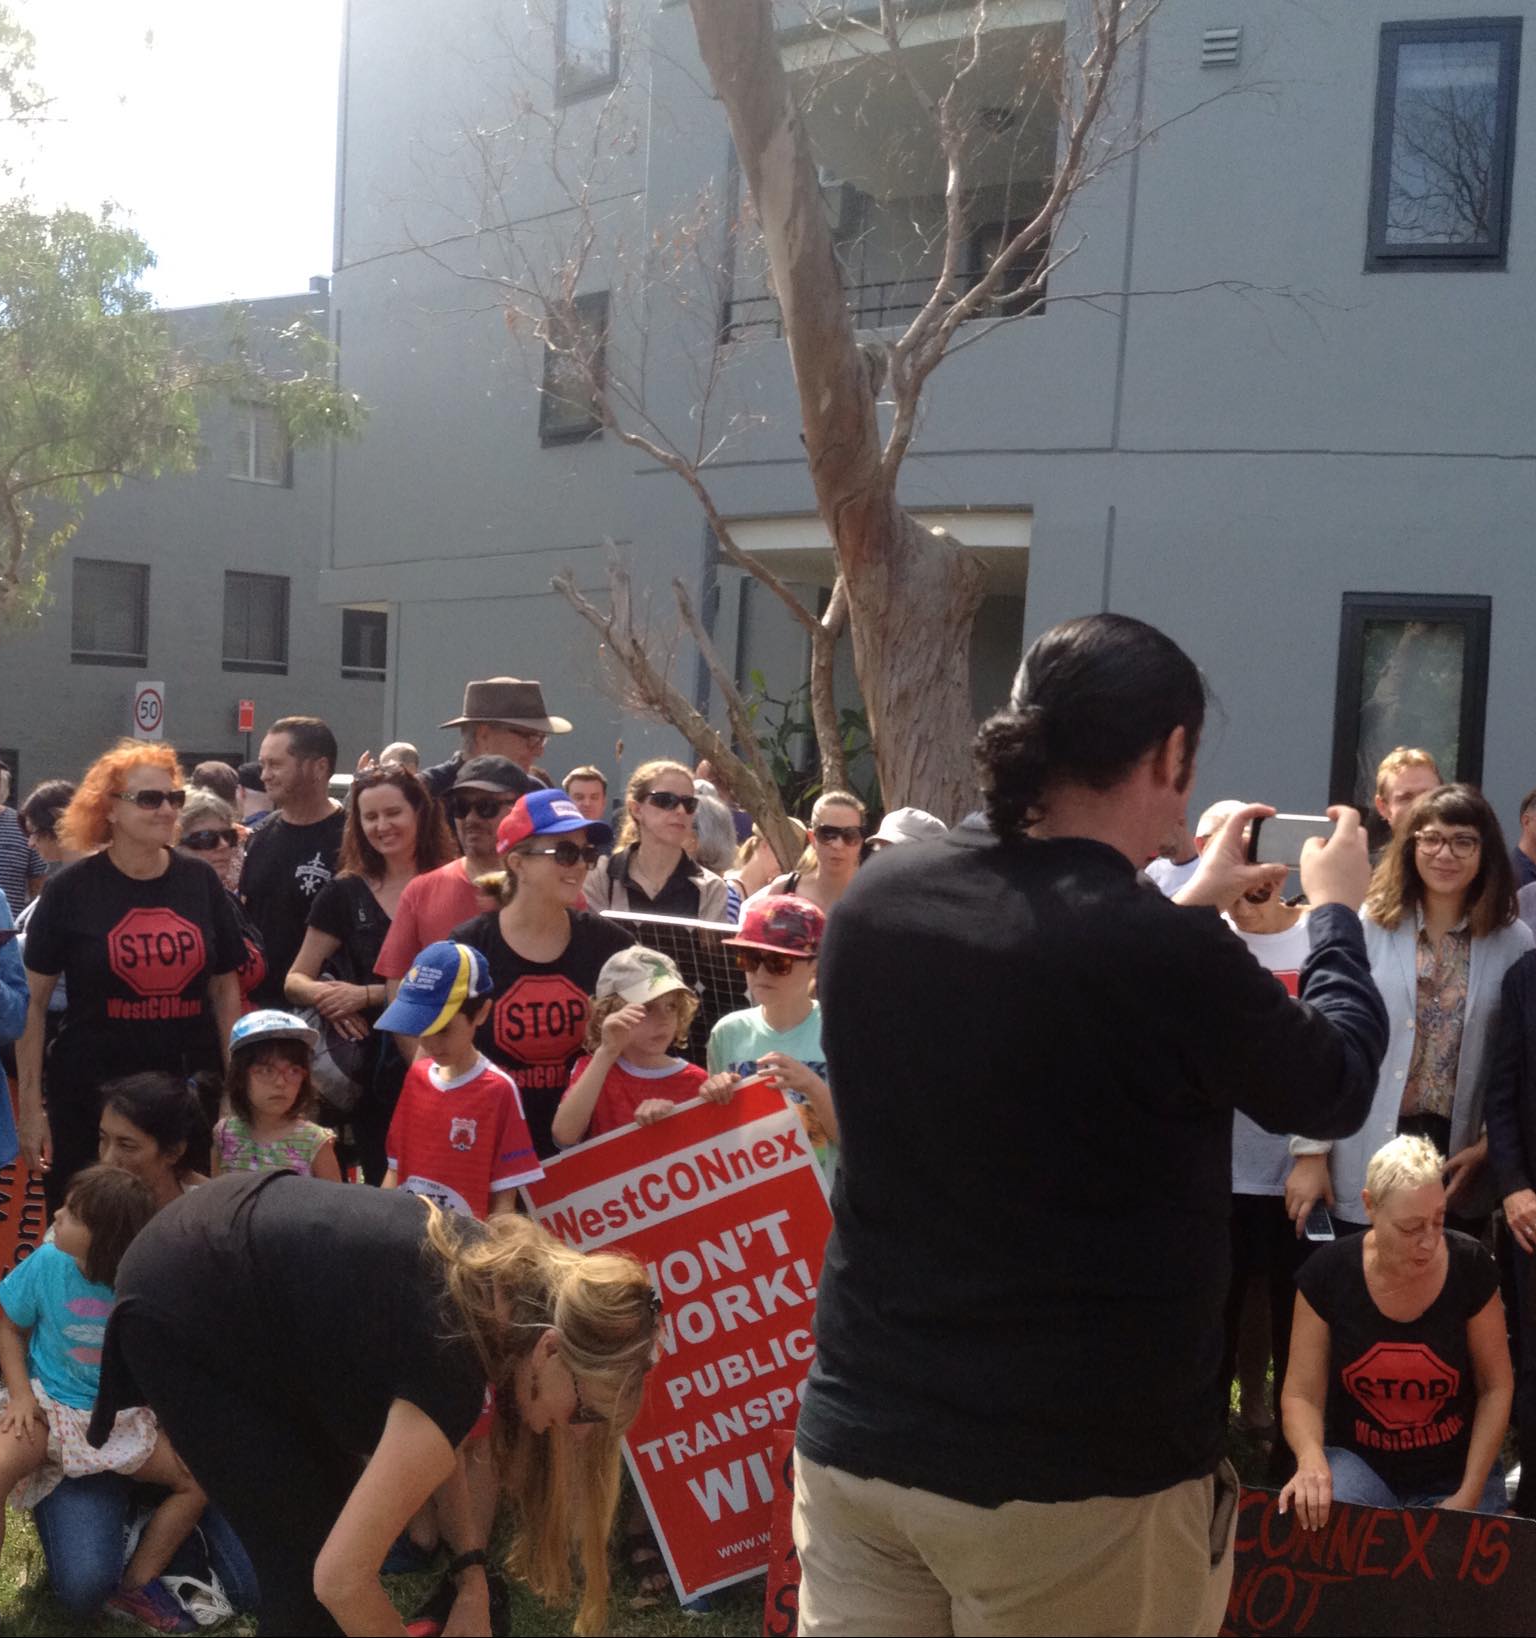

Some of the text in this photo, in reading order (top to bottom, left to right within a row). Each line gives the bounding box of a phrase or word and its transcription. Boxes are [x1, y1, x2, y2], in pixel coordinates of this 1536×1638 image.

[140, 701, 158, 719] 50
[119, 931, 197, 969] STOP
[505, 999, 585, 1041] STOP
[540, 1128, 807, 1246] WestCONnex
[666, 1328, 816, 1410] PUBLIC
[637, 1378, 810, 1473] TRANSP
[1457, 1519, 1512, 1586] IS
